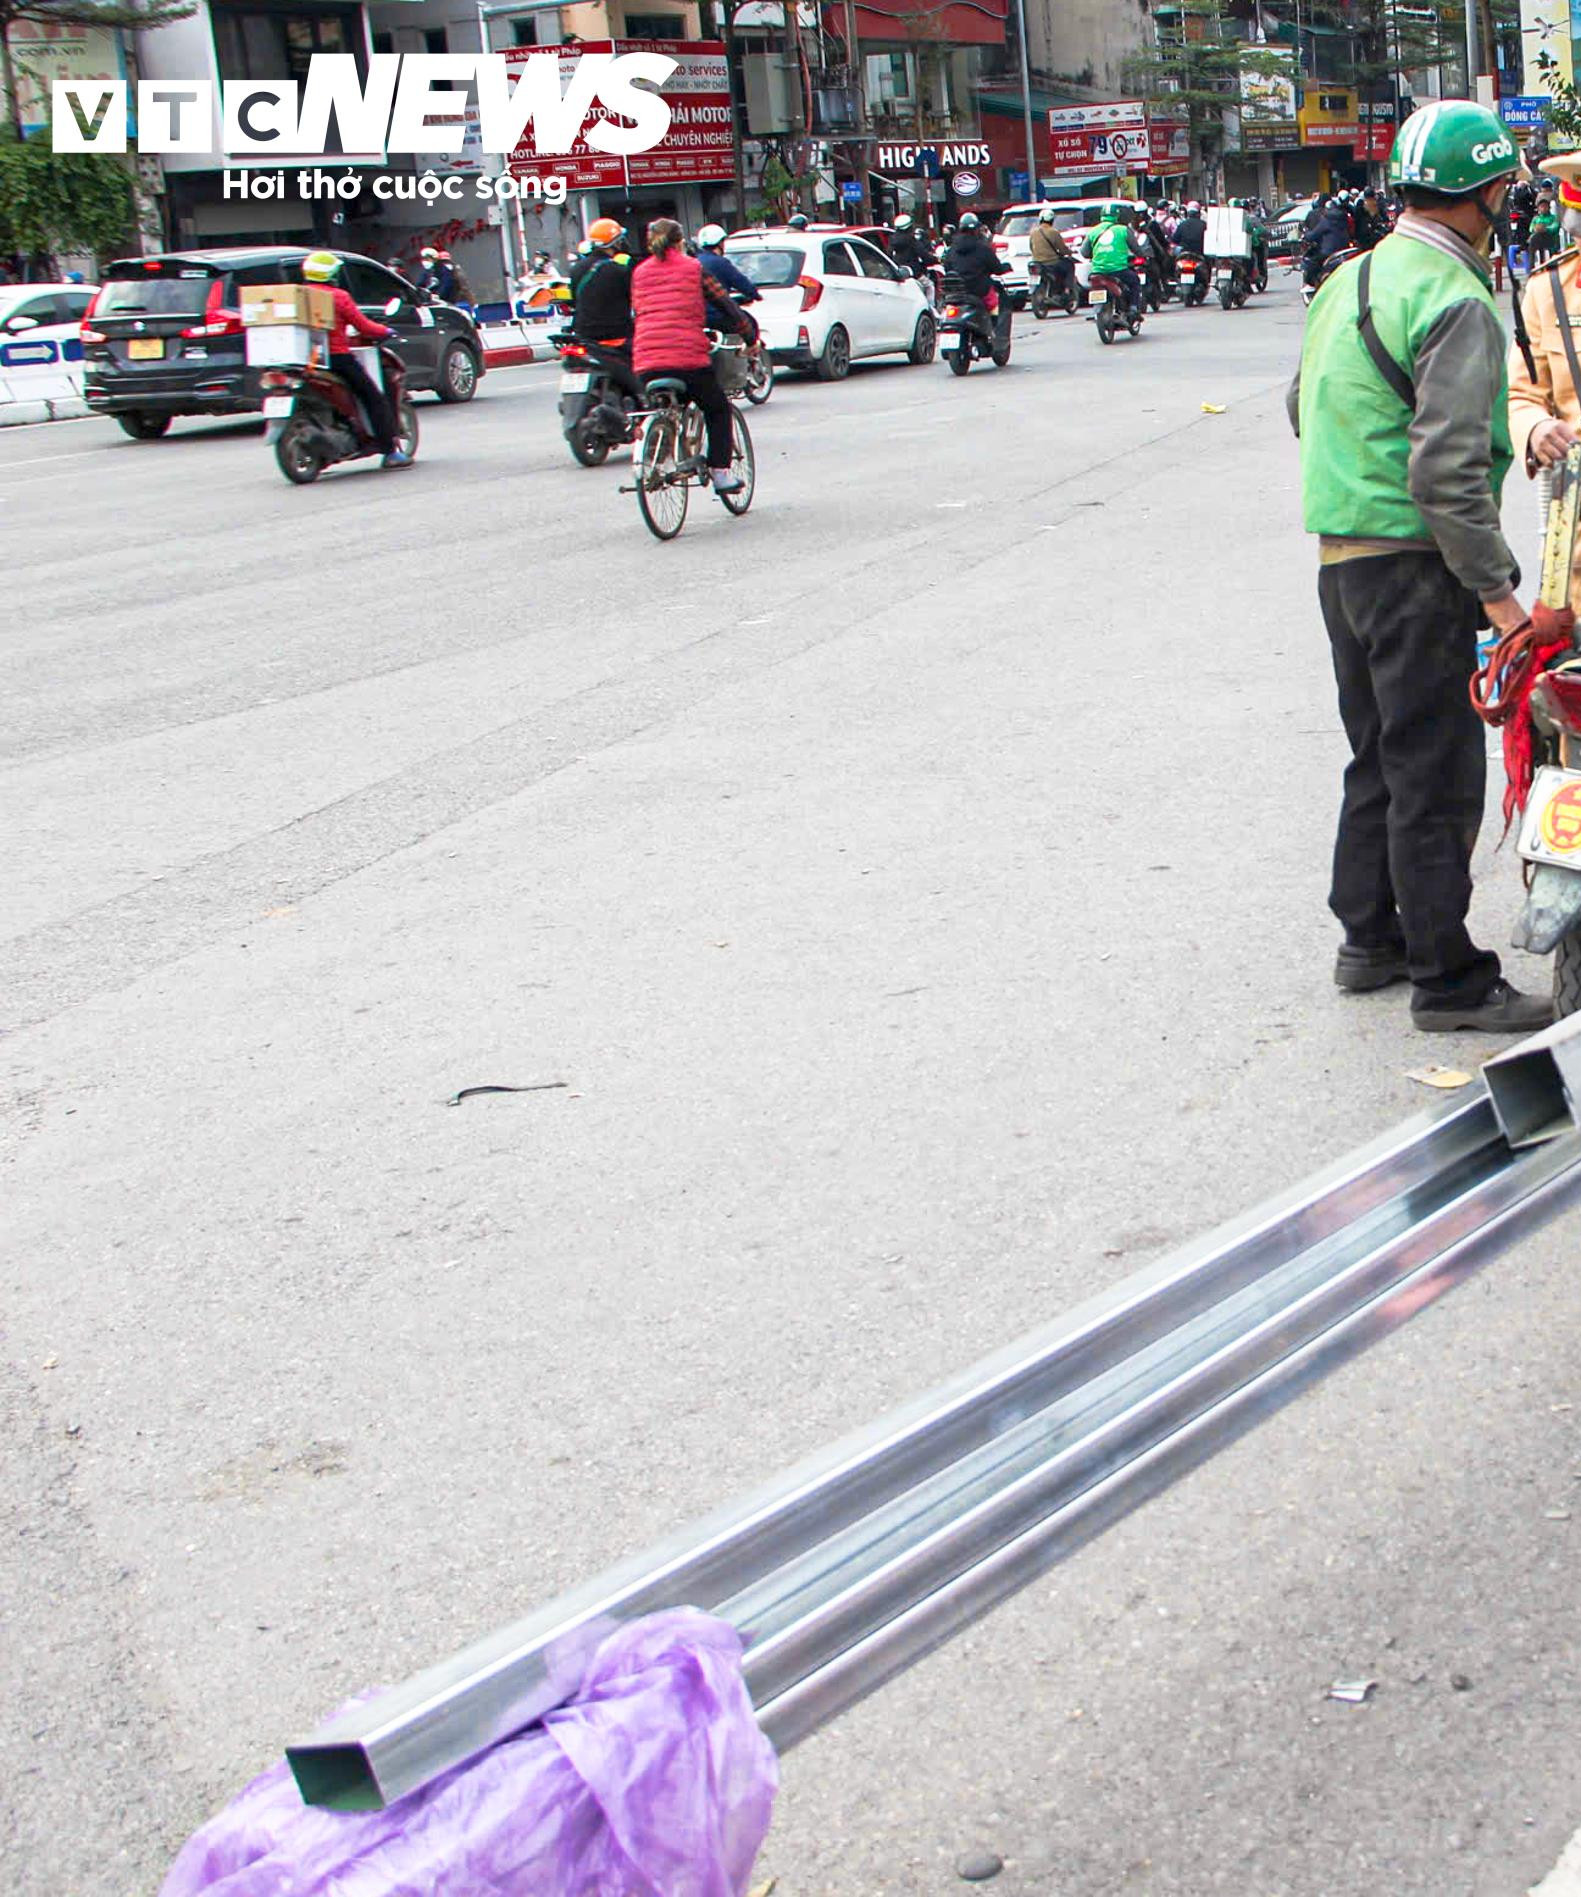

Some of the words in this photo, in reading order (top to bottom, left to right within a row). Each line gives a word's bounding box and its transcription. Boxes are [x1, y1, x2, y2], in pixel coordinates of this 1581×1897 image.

[688, 62, 726, 76] services
[664, 130, 702, 147] CHUYÊN
[1471, 134, 1513, 165] Grab
